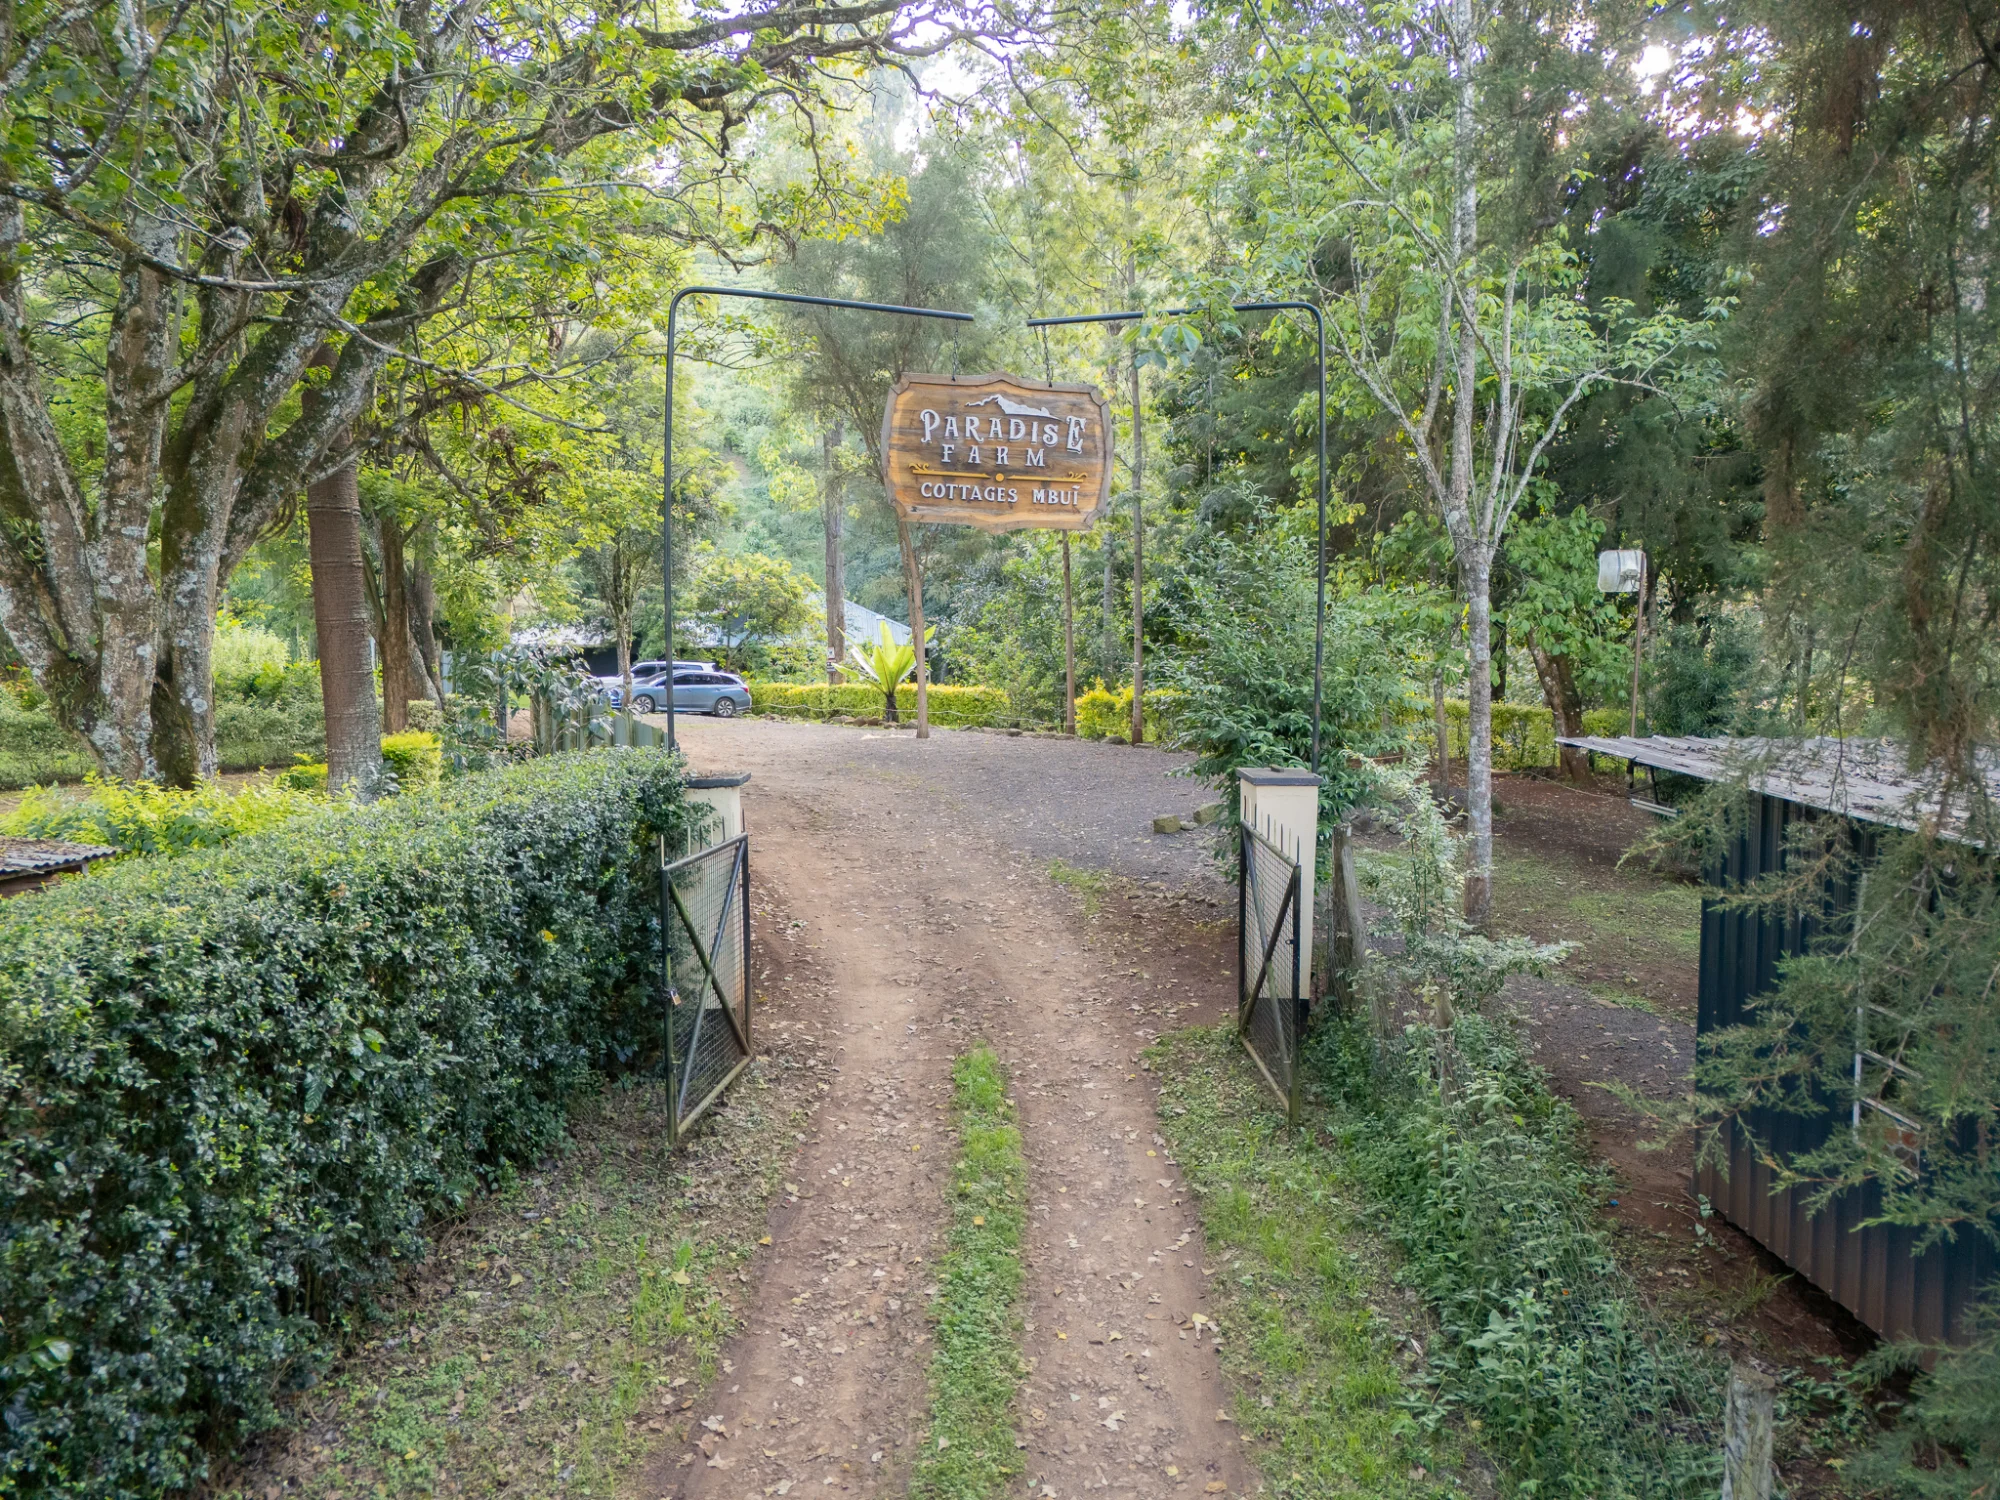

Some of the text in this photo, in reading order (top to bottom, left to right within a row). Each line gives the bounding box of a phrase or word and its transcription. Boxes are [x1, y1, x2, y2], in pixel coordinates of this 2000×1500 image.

[920, 409, 1087, 454] PARADISE
[941, 444, 1046, 467] FARM
[920, 482, 1018, 503] COTTAGES
